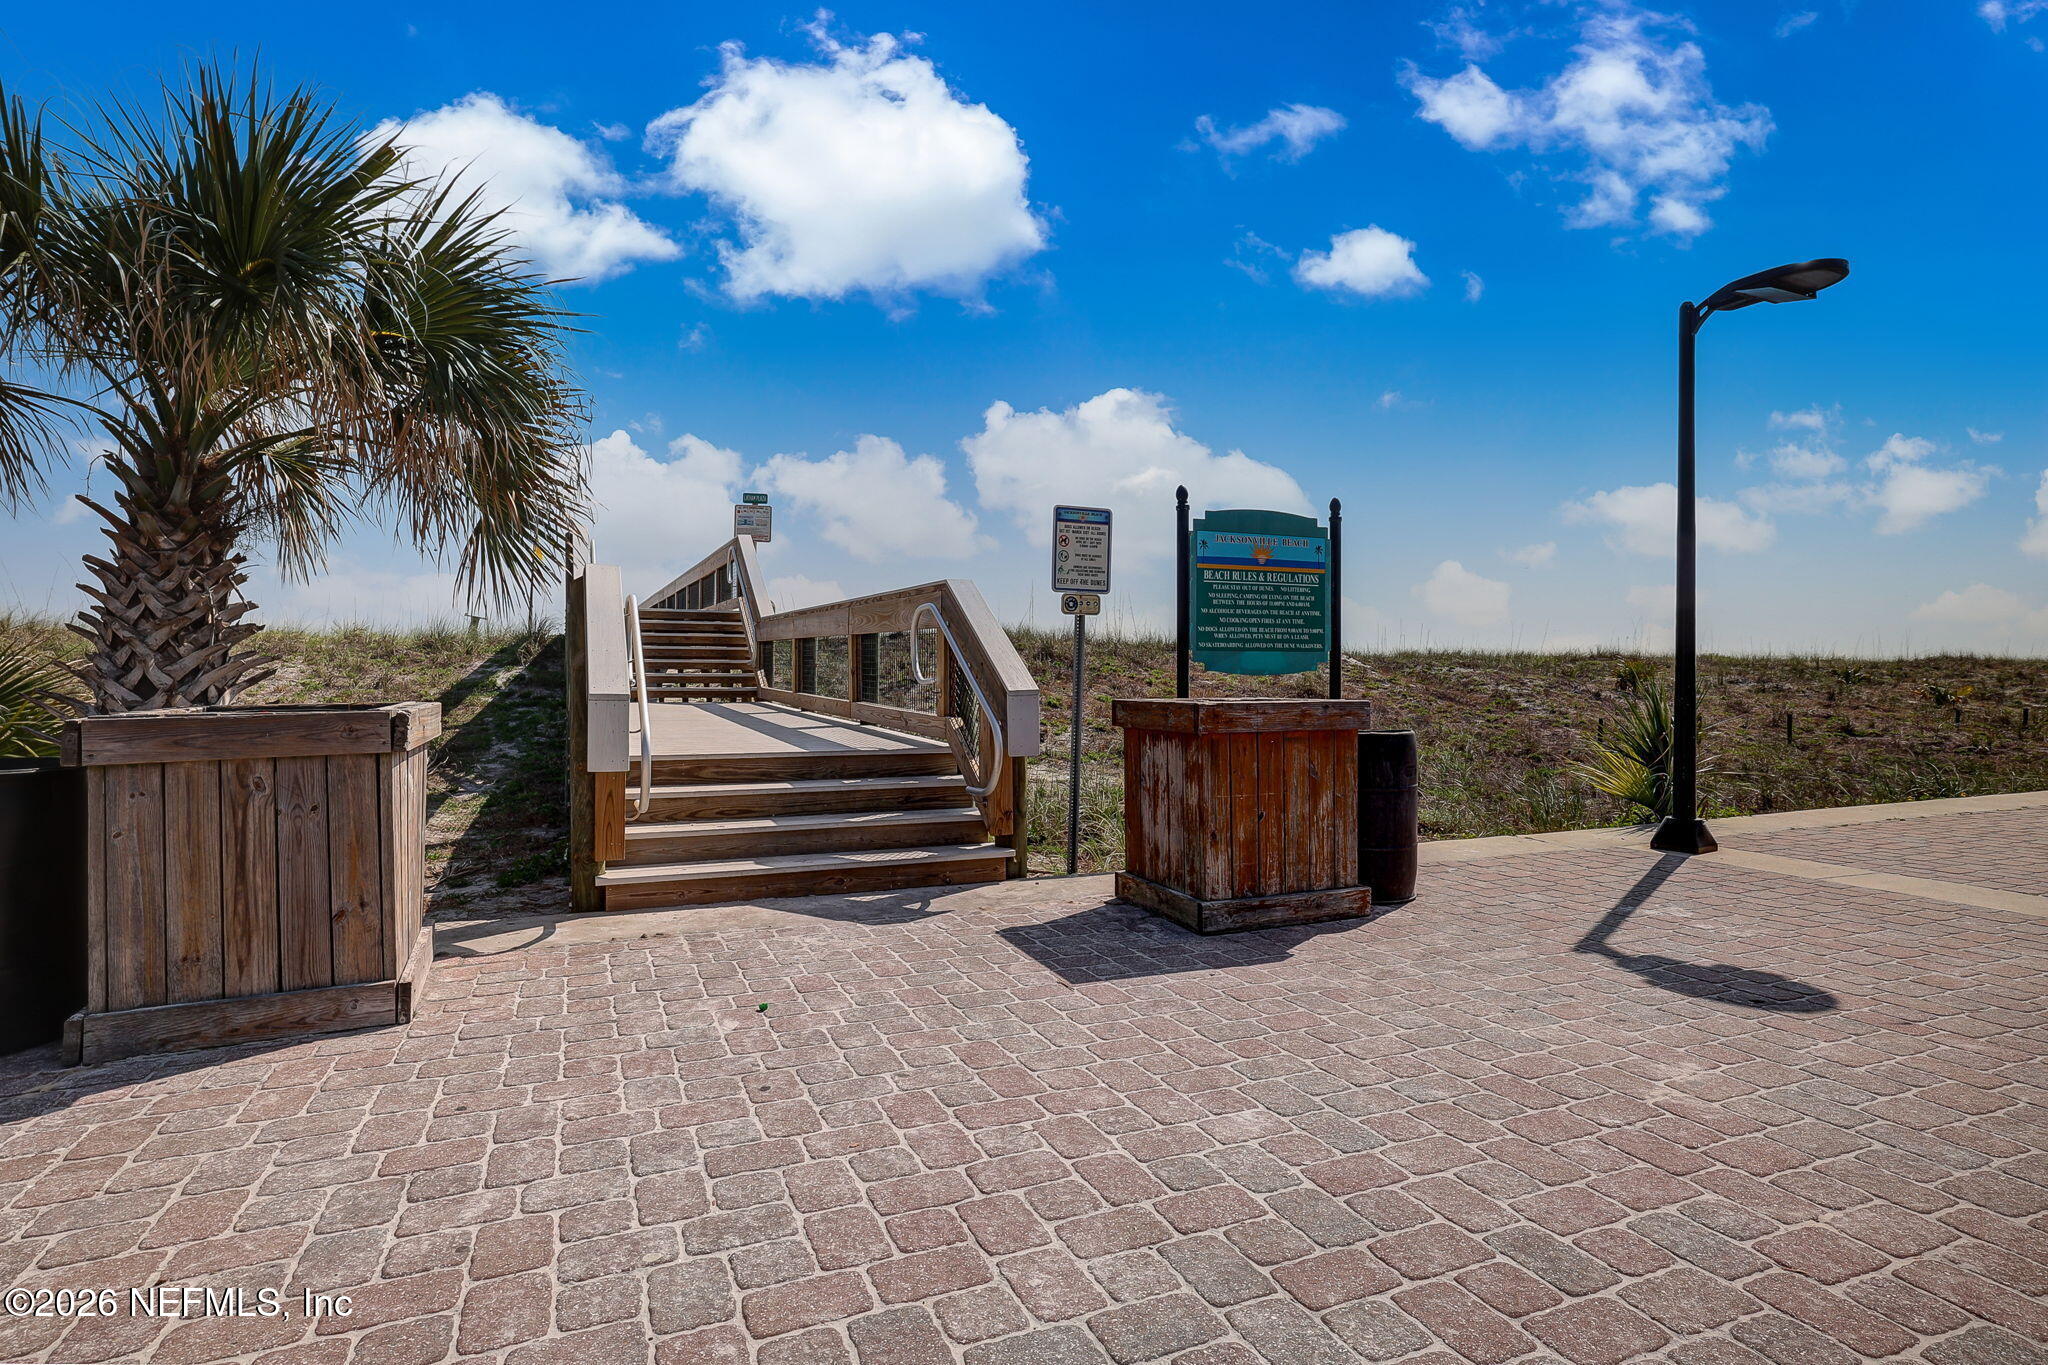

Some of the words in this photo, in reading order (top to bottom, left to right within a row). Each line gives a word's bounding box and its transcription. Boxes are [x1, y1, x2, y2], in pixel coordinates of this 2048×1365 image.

[1215, 534, 1278, 546] JACKSONVILLE
[1282, 538, 1309, 548] BEACH
[1203, 569, 1230, 580] BEACH
[1232, 571, 1258, 581] RULES
[1258, 572, 1265, 582] &
[1267, 572, 1320, 584] REGULATIONS
